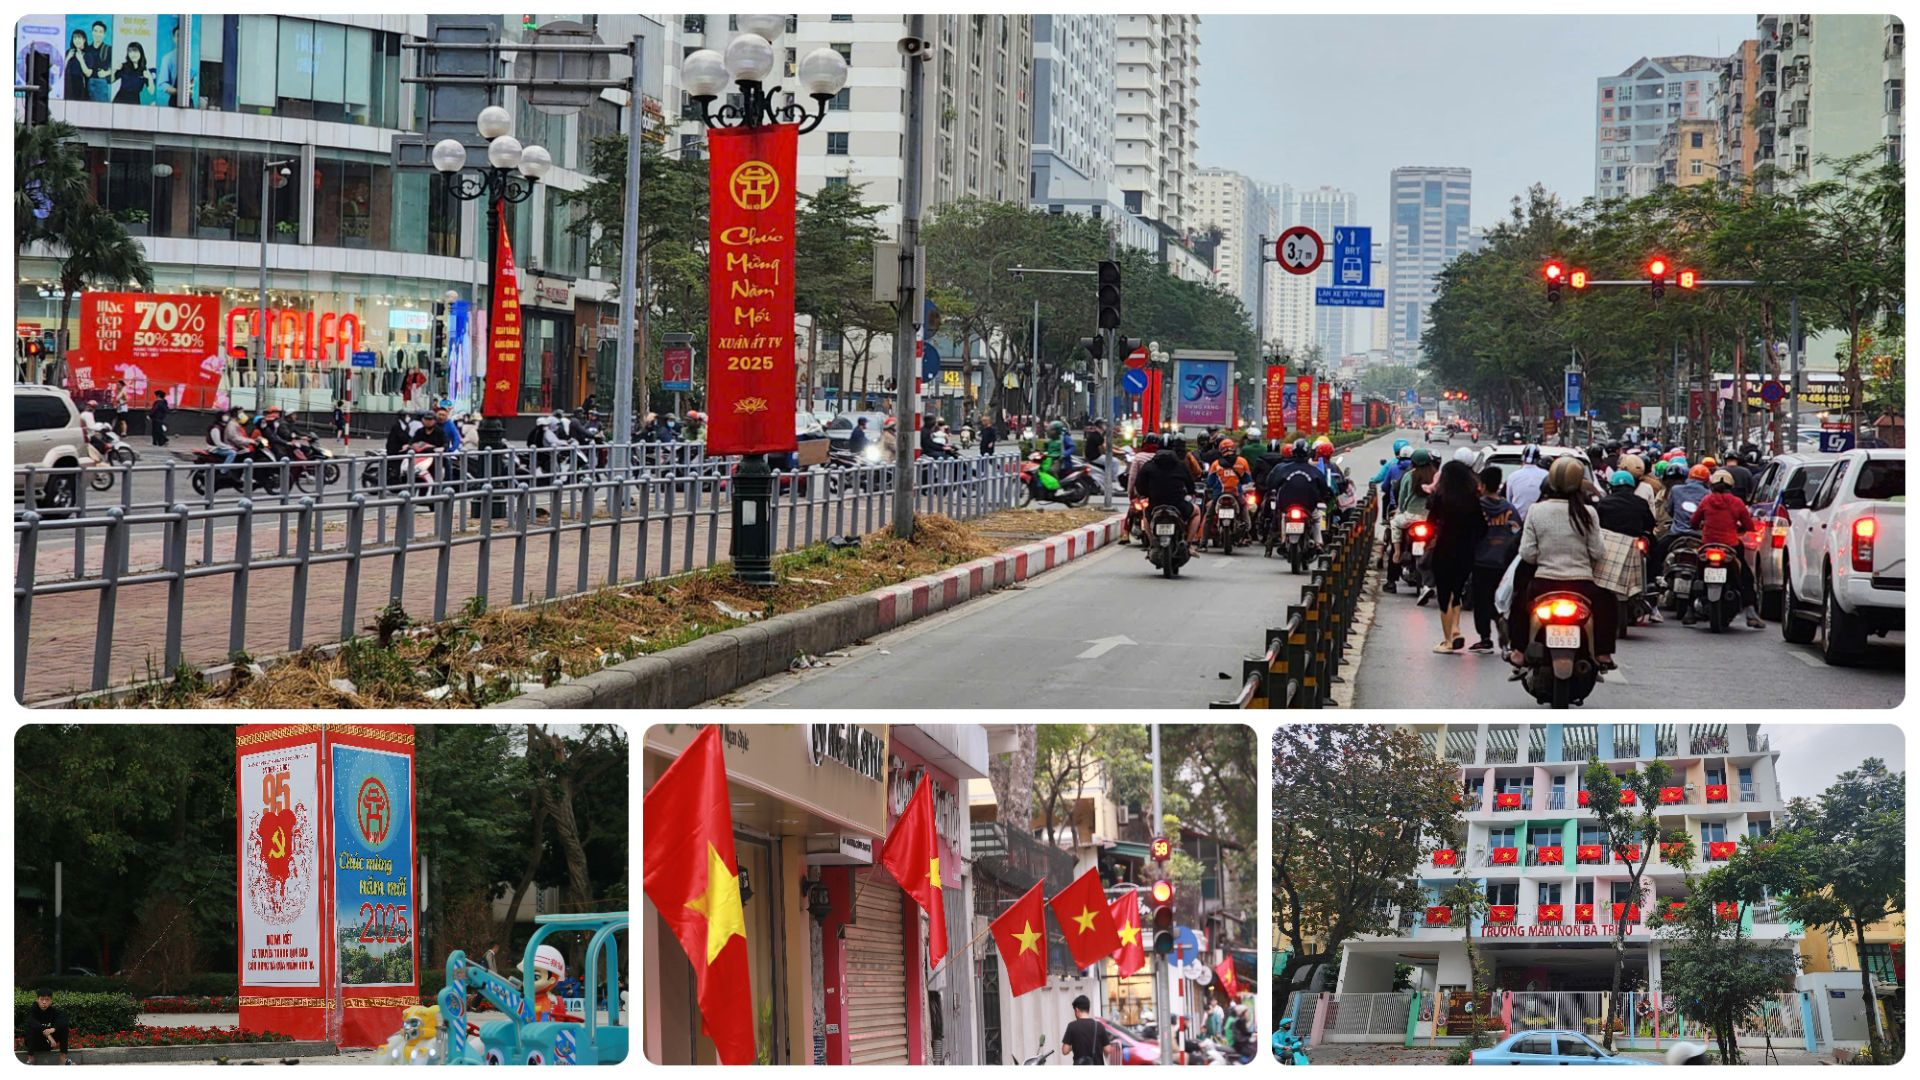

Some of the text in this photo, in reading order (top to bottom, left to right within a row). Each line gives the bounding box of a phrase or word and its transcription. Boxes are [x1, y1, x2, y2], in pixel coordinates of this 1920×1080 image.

[720, 226, 784, 246] Chúc
[1344, 246, 1361, 256] BRT
[726, 251, 780, 286] Mừng
[731, 279, 775, 300] Năm
[1571, 271, 1586, 288] 18
[1680, 271, 1694, 288] 18
[134, 301, 206, 332] 70%
[735, 306, 771, 328] Mới
[133, 332, 169, 347] 50%
[170, 332, 204, 348] 30%
[727, 356, 774, 371] 2025
[1828, 434, 1847, 452] G7
[262, 772, 291, 815] 95
[1153, 841, 1168, 856] 58
[339, 851, 364, 871] Chúc
[359, 876, 385, 897] năm
[359, 902, 408, 944] 2025
[1557, 924, 1581, 937] NON
